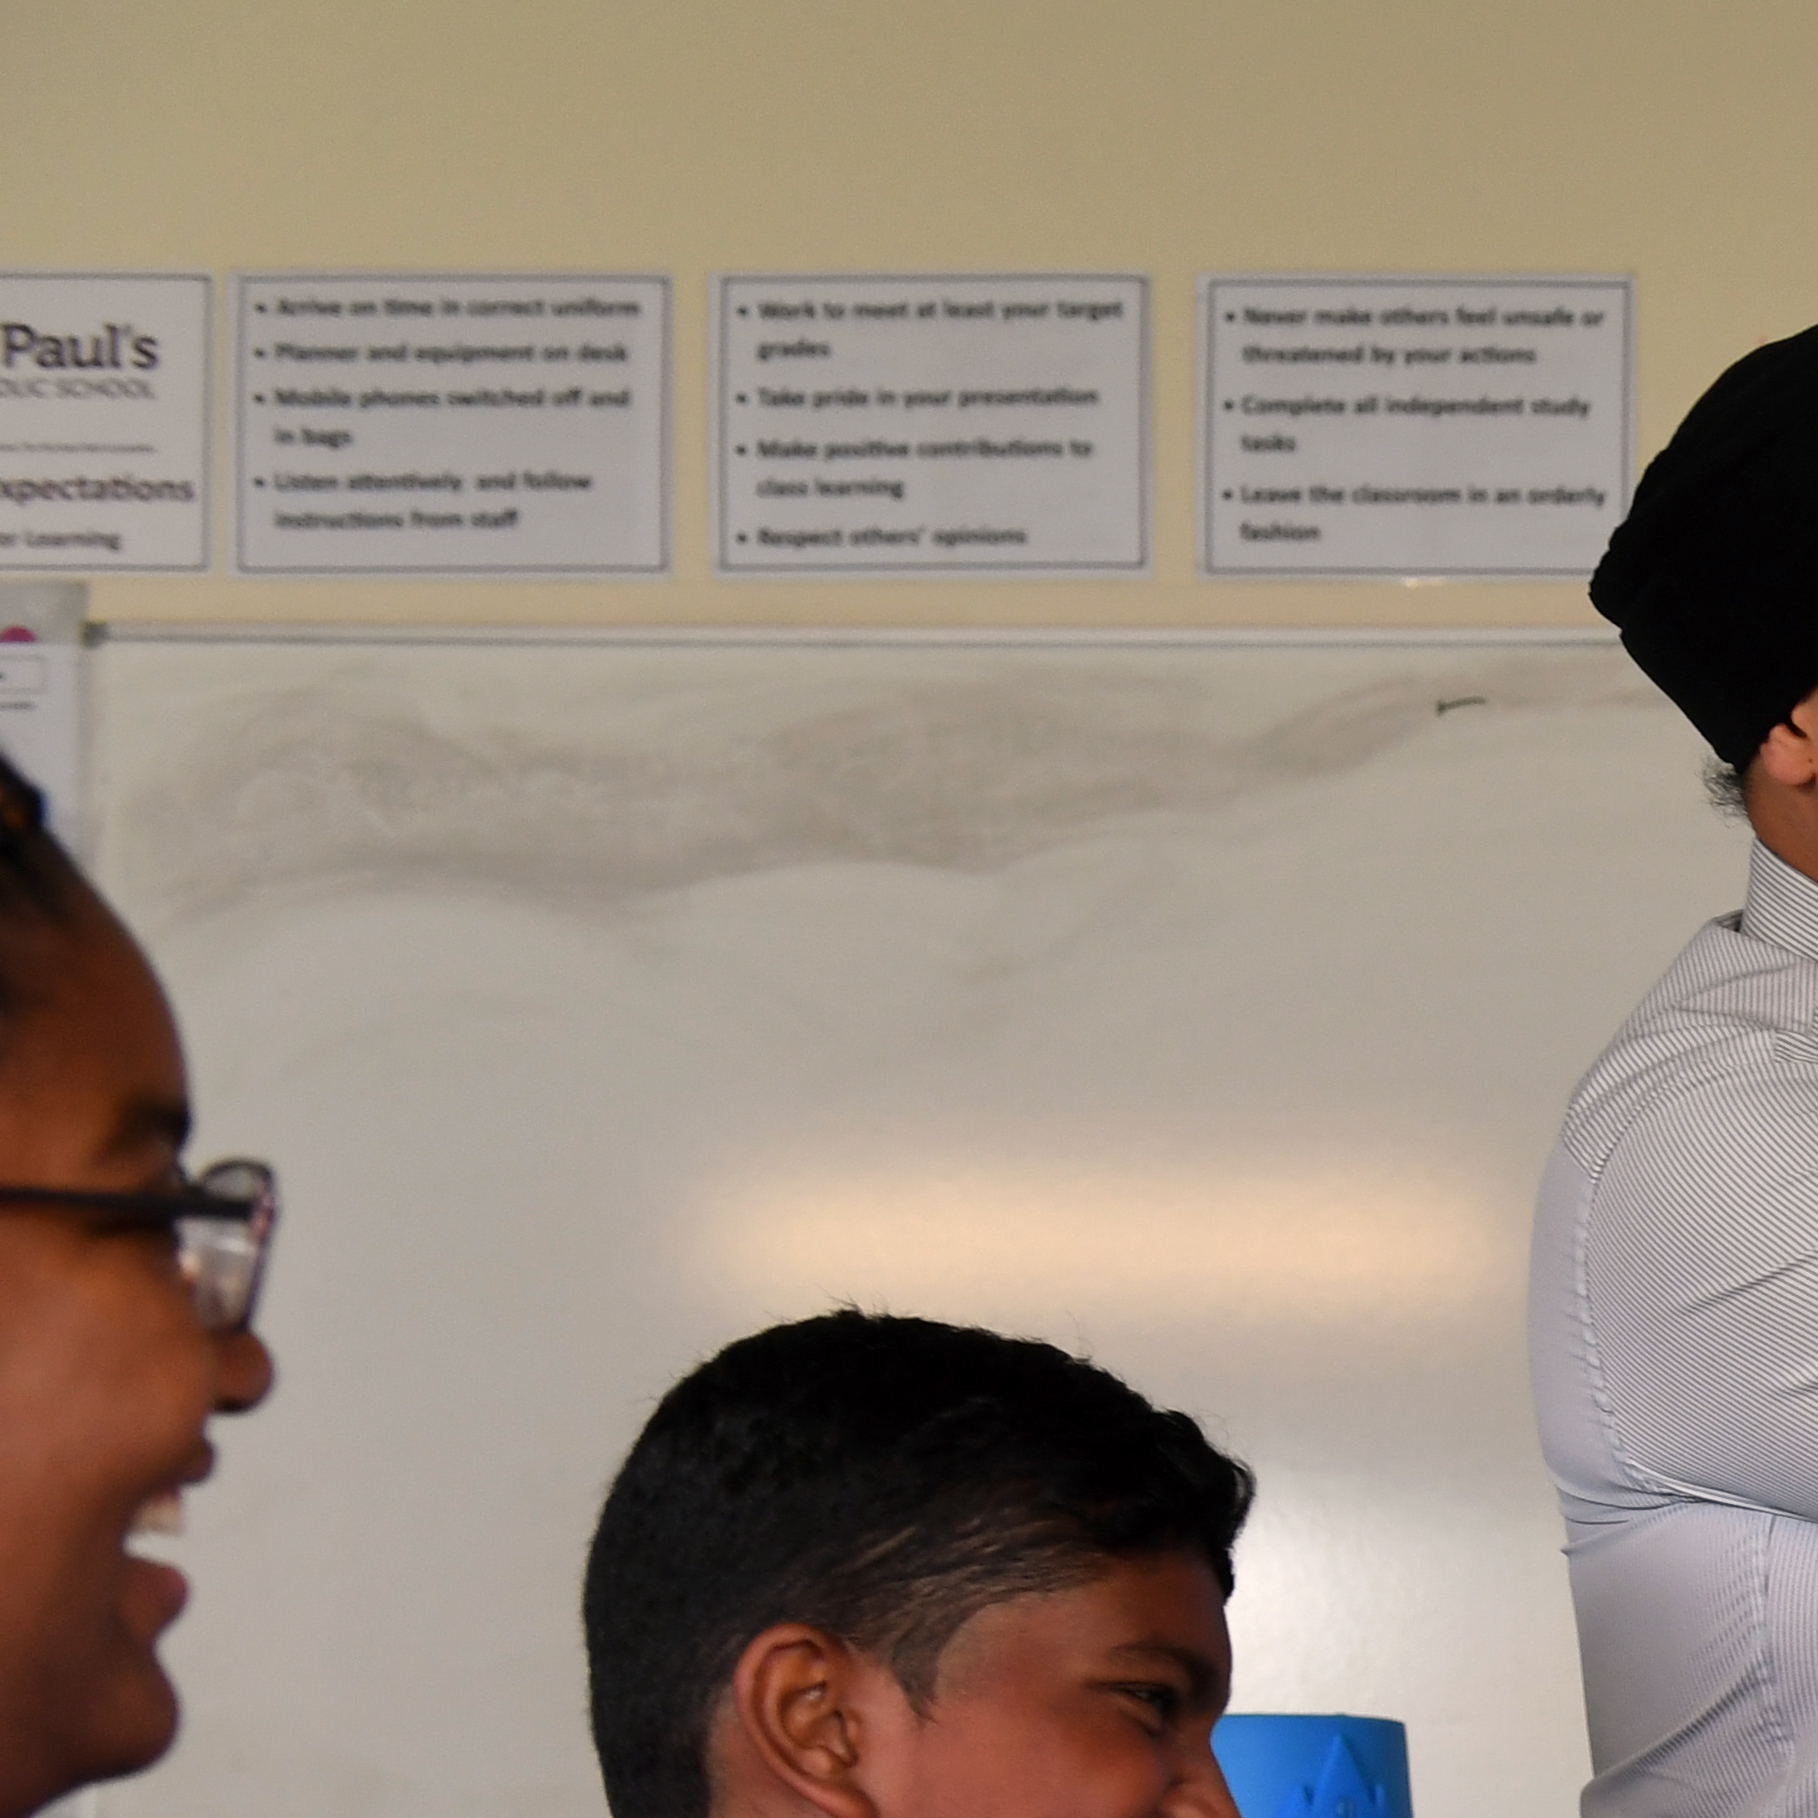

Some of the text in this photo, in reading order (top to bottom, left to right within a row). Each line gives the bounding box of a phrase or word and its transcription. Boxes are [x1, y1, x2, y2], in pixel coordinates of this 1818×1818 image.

[276, 299, 342, 316] Arrive
[348, 302, 377, 316] on
[440, 300, 460, 315] in
[466, 300, 545, 317] correct
[551, 298, 641, 317] uniform
[758, 301, 1123, 322] Work to meet at least your target
[1243, 308, 1307, 326] Never
[1314, 308, 1373, 326] make
[1379, 308, 1450, 326] others
[1503, 308, 1574, 326] unsafe
[1581, 313, 1603, 326] or
[0, 323, 158, 369] Paul's
[275, 343, 628, 364] Planner and equipment on desk
[757, 339, 830, 361] grades
[1243, 346, 1536, 365] threatened by your actions
[274, 387, 631, 409] Mobile phones switched off and
[759, 388, 1099, 410] Take pride in your presentation
[1241, 396, 1590, 418] Complete all independent study
[275, 429, 353, 450] in bags
[757, 438, 1093, 461] Make positive contributions to
[1241, 435, 1296, 452] tasks
[0, 476, 195, 505] xpectations
[275, 471, 592, 493] Listen attentively and follow
[757, 479, 904, 500] class learning
[1241, 486, 1605, 507] Leave the classroom in an orderly
[275, 512, 405, 529] instructions
[410, 510, 464, 528] from
[758, 528, 843, 549] Respect
[932, 528, 1027, 547] opinions
[1240, 523, 1320, 541] fashion
